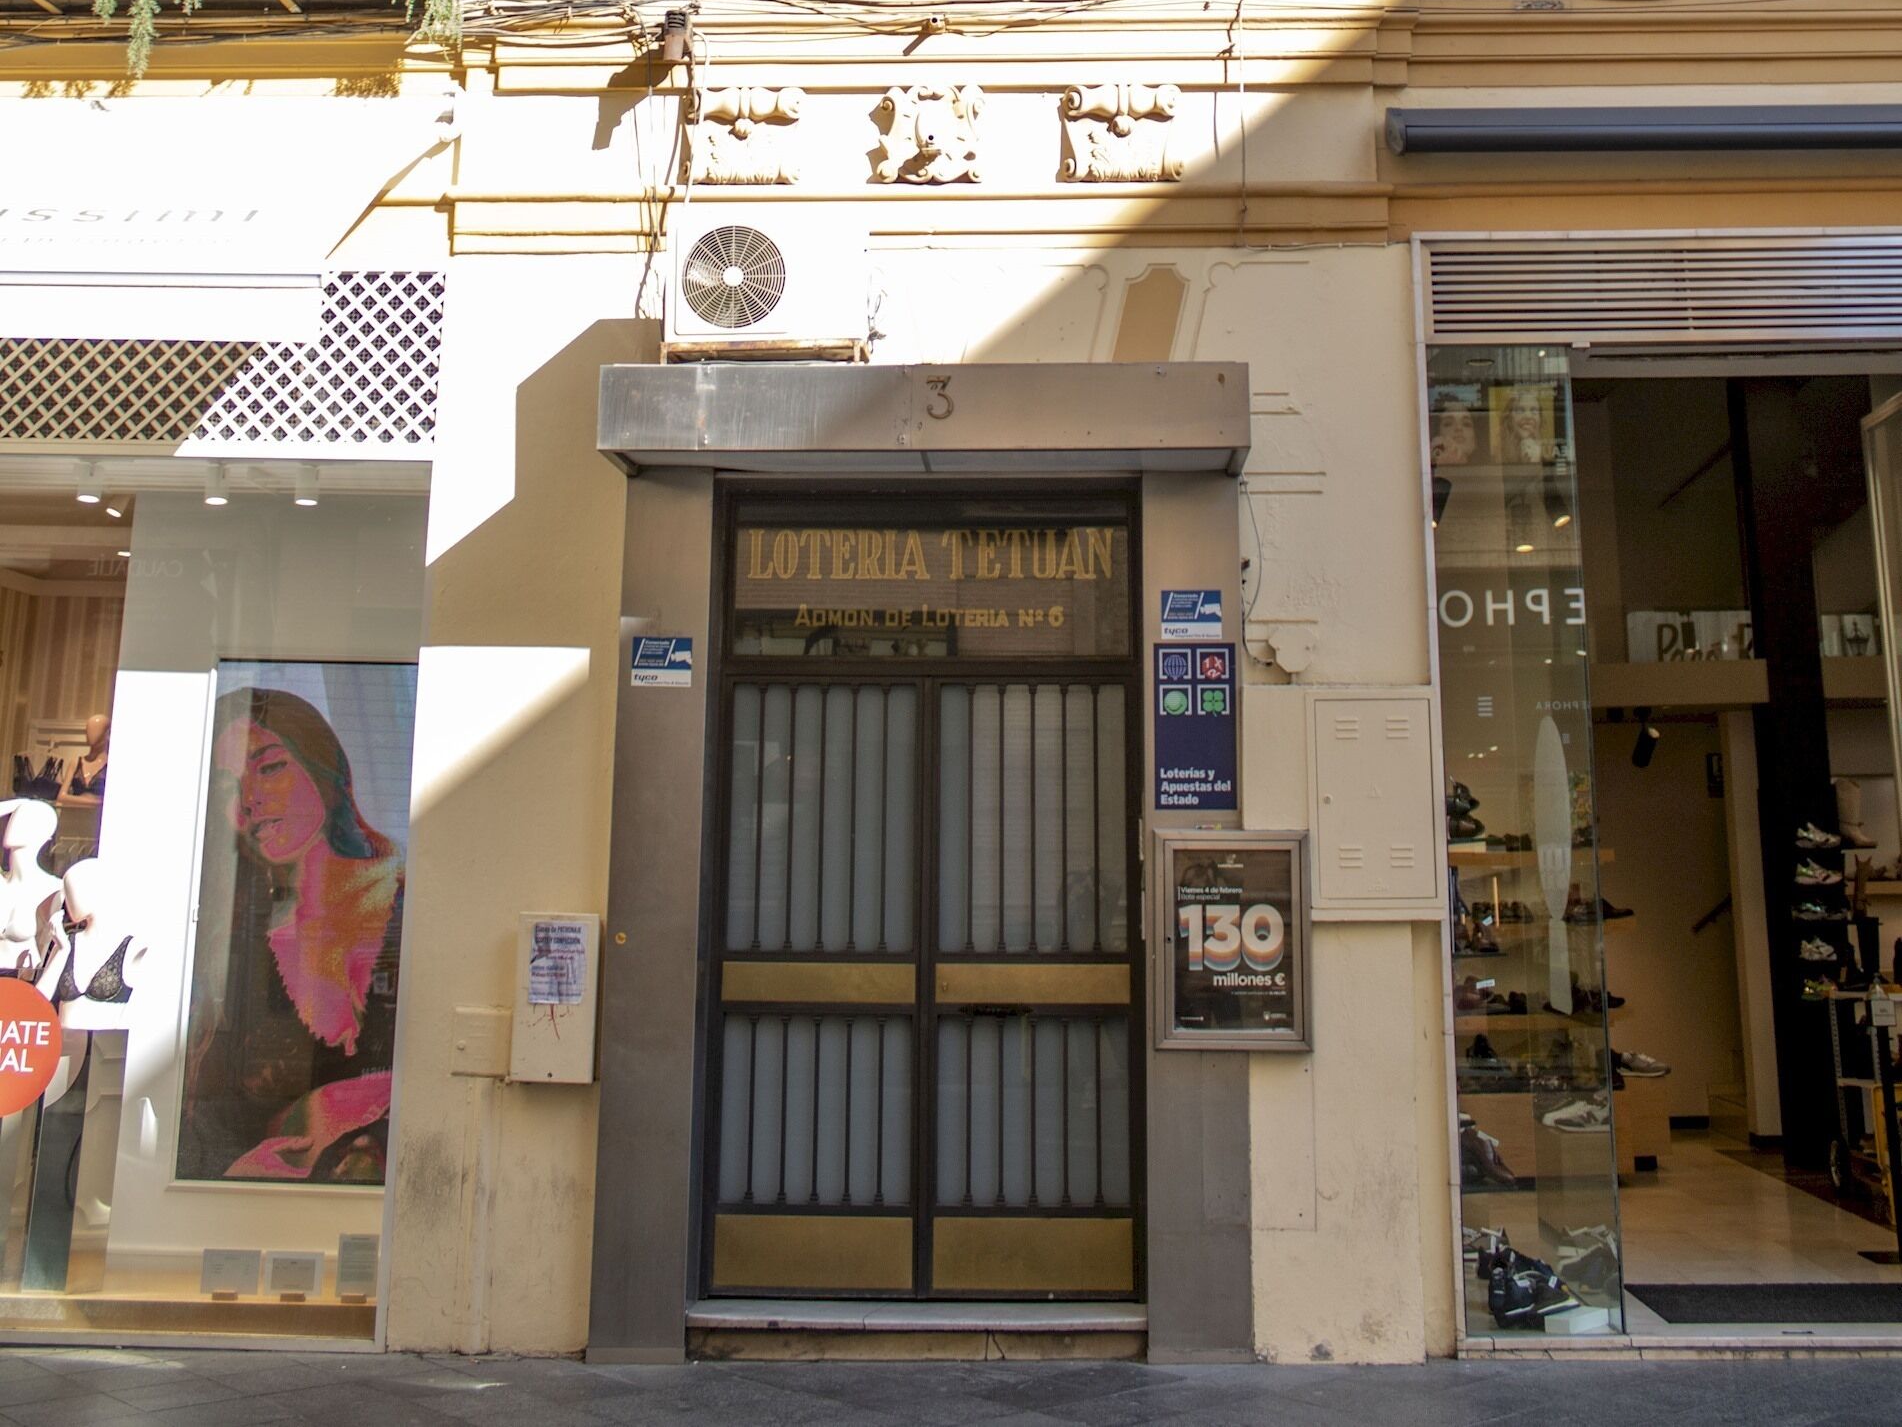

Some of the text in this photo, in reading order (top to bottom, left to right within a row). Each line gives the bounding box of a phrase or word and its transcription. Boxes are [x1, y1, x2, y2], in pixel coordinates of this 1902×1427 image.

[925, 375, 955, 420] 3
[748, 527, 1114, 580] LOTERIA TETUAN
[795, 603, 879, 627] ADMON.
[886, 608, 912, 627] DE
[922, 604, 1009, 627] LOTERIA
[1048, 605, 1065, 628] 6
[1164, 627, 1189, 636] tyco
[634, 674, 658, 682] tyco
[1160, 767, 1215, 781] Loterías y
[1161, 780, 1232, 794] Apuestas del
[1160, 794, 1199, 805] Estado
[1178, 904, 1285, 971] 130
[1213, 972, 1286, 987] millones €
[0, 1020, 51, 1045] ATE
[0, 1048, 34, 1073] AL
